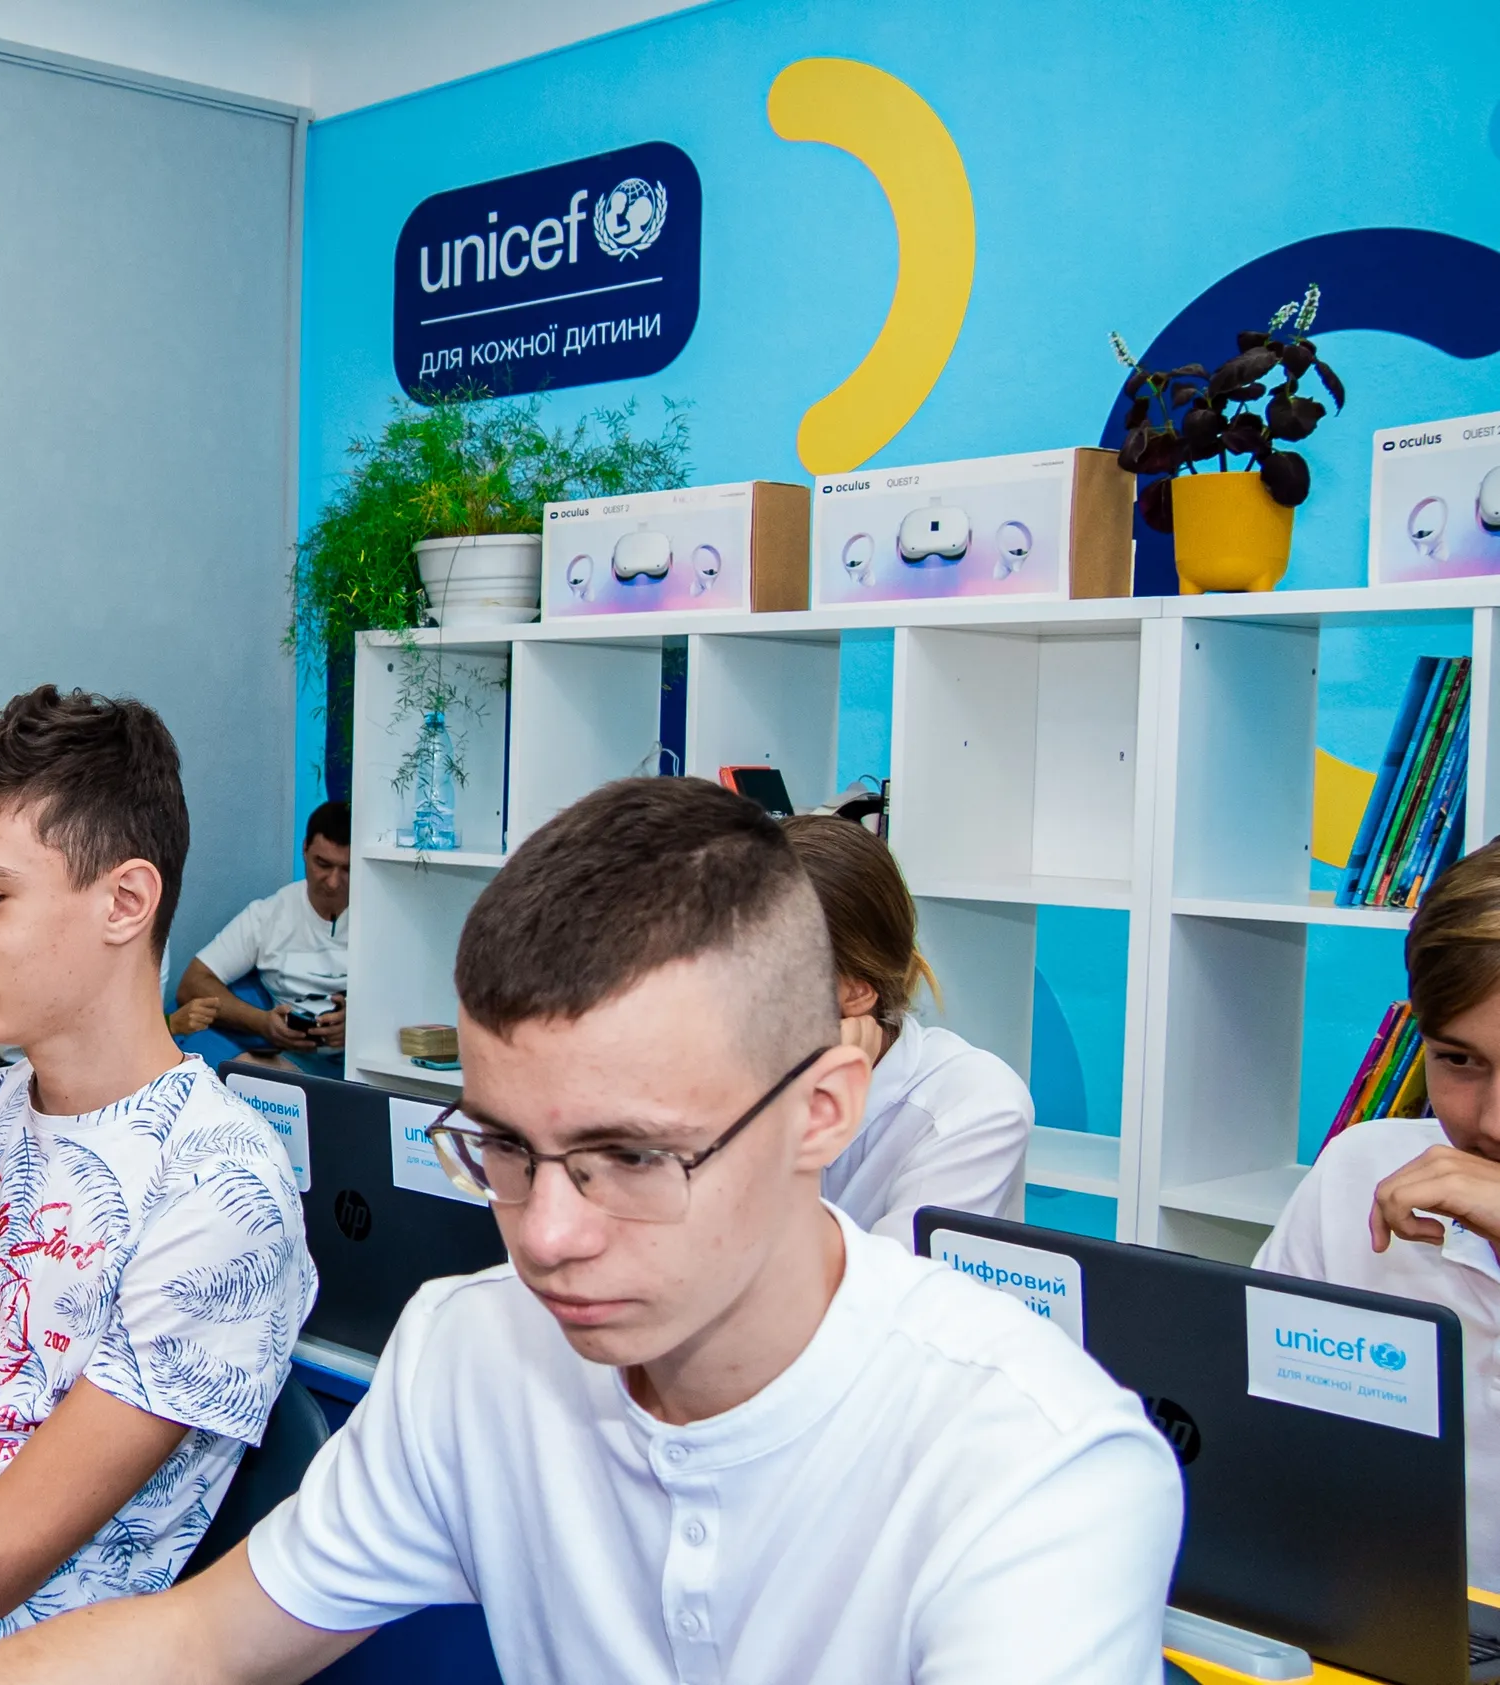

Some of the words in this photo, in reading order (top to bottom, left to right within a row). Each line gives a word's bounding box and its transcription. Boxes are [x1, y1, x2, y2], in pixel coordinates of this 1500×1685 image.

[419, 189, 588, 293] unicef
[1399, 433, 1442, 449] oculus
[1463, 425, 1495, 440] QUEST
[835, 479, 871, 493] oculus
[886, 477, 913, 489] QUEST
[914, 475, 920, 485] 2
[560, 507, 590, 519] oculus
[603, 504, 624, 515] QUEST
[233, 1091, 300, 1119] ифровий
[44, 1329, 71, 1353] 2021
[1275, 1327, 1367, 1363] unicef
